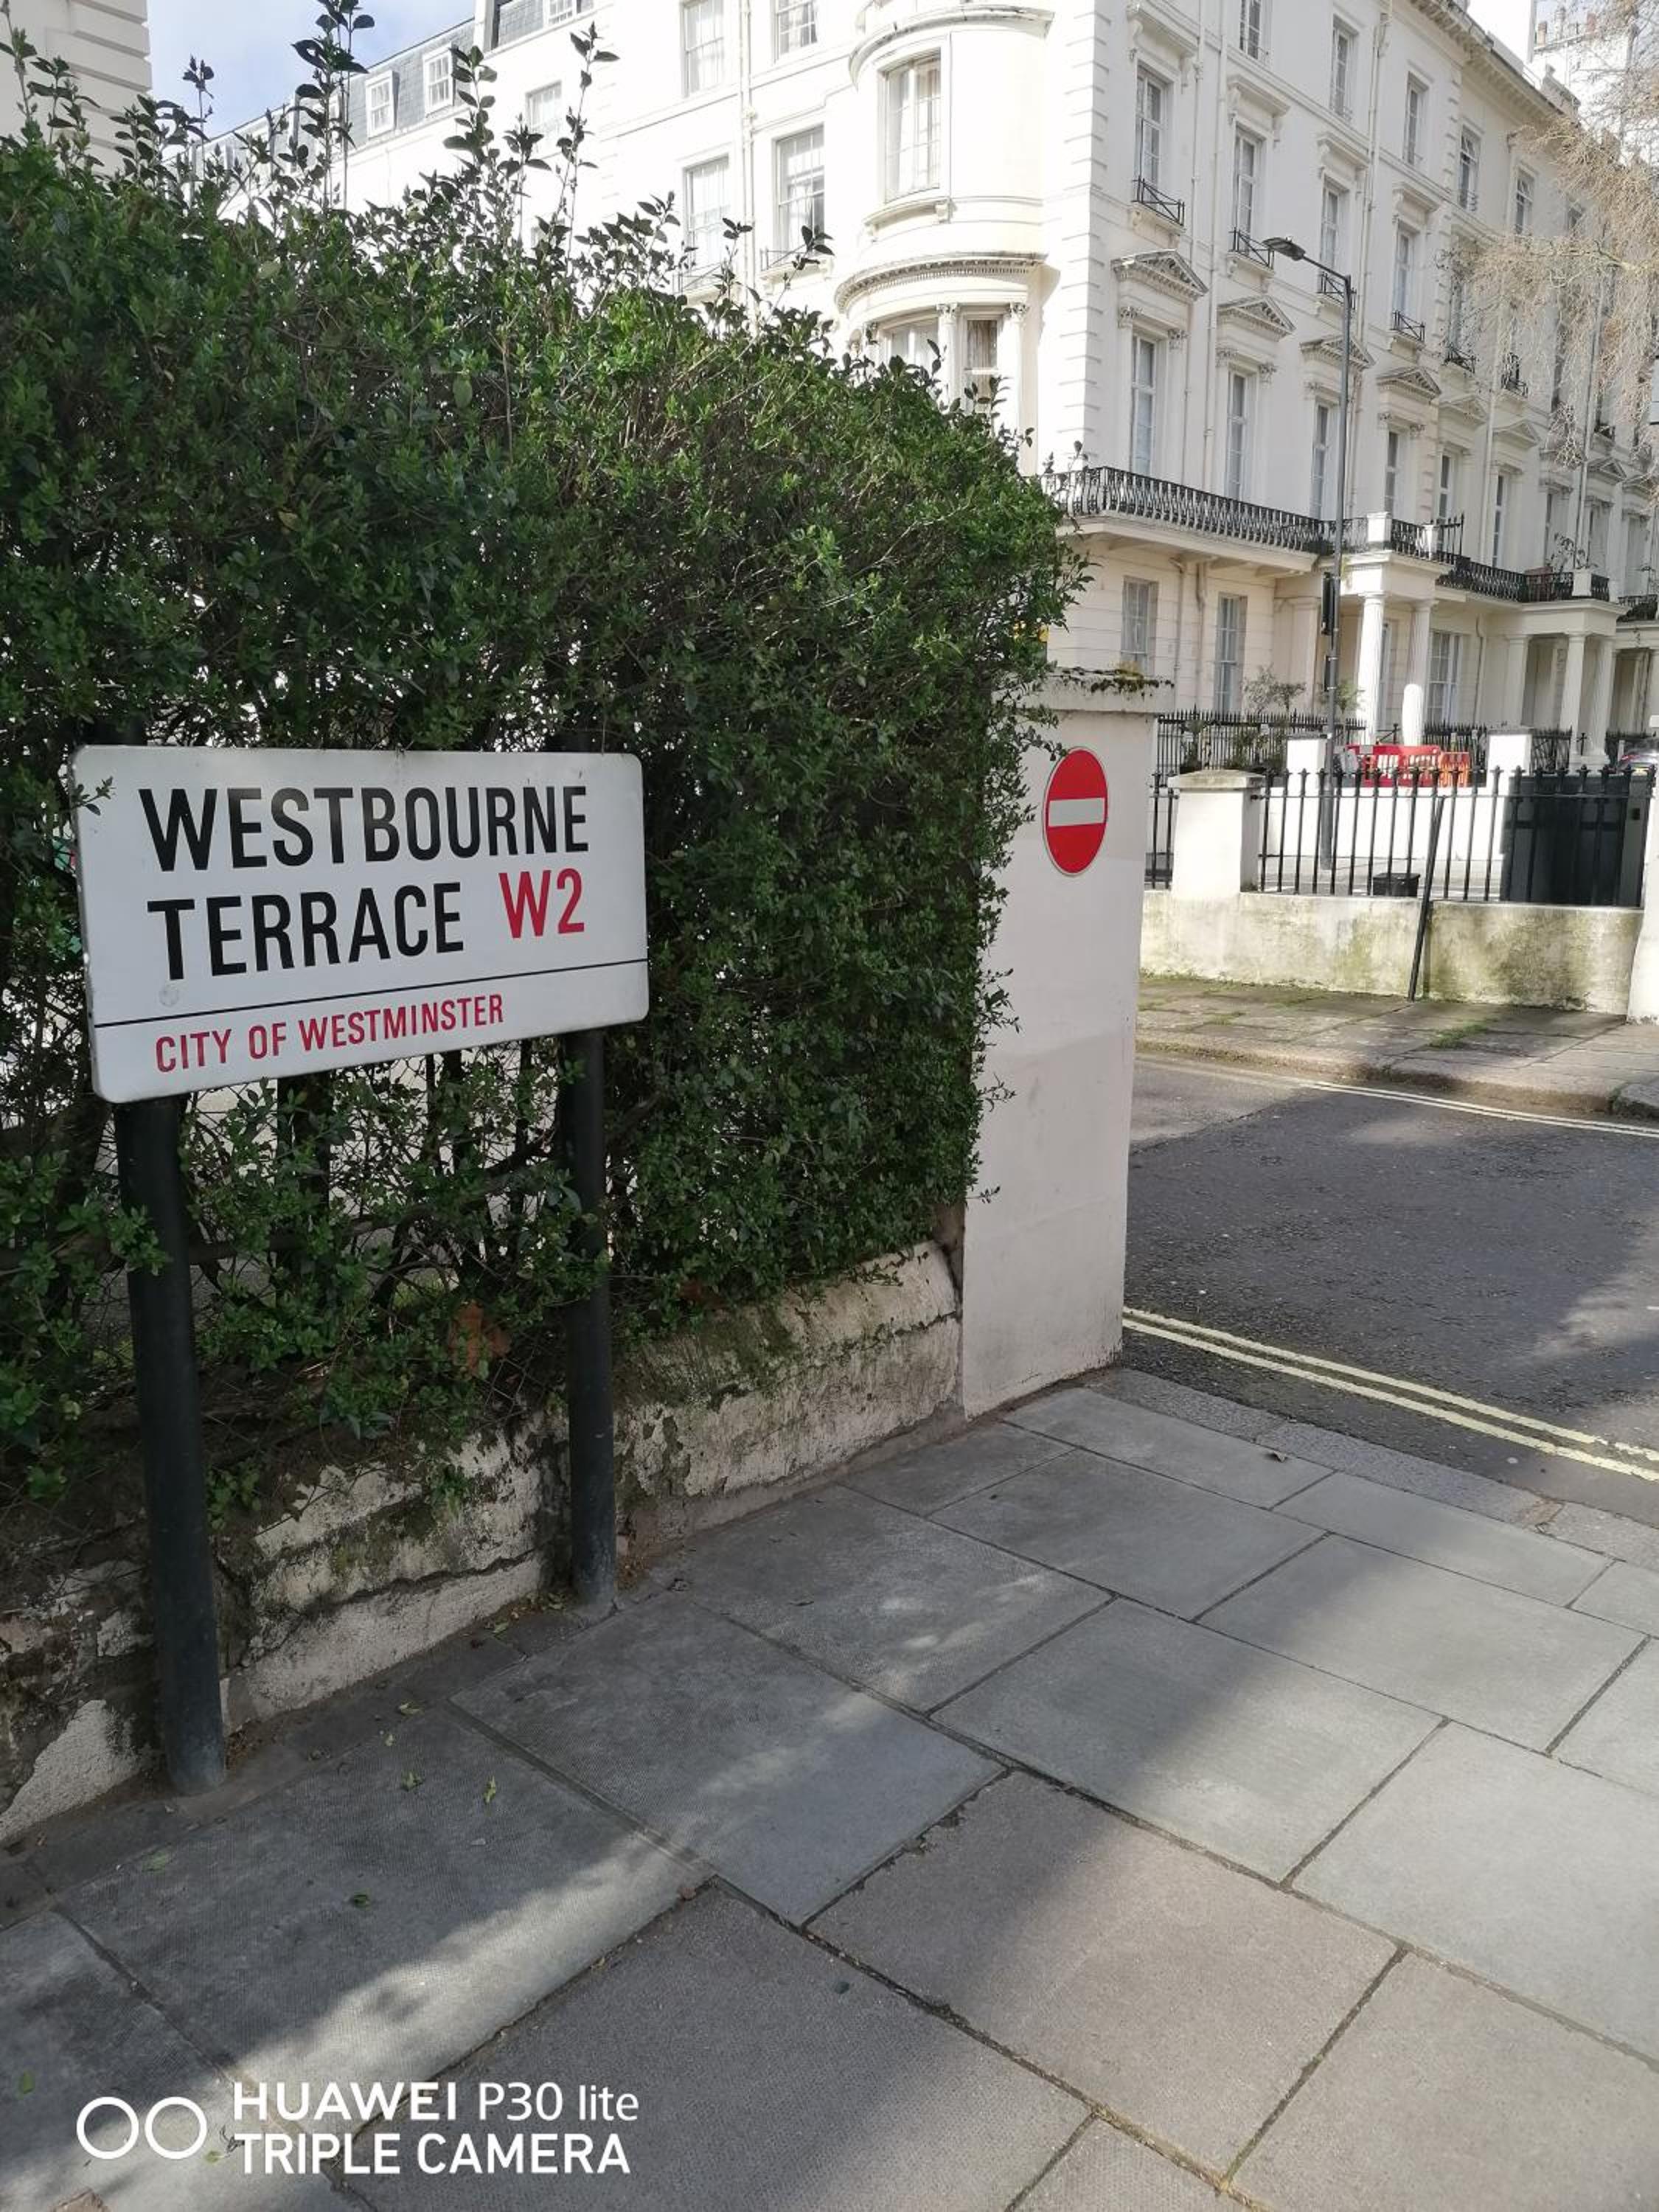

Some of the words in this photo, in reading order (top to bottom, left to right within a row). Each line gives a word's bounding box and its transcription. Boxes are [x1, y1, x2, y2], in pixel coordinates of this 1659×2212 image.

[139, 785, 589, 872] WESTBOURNE
[147, 882, 465, 981] TERRACE
[498, 868, 585, 939] W2
[156, 1029, 232, 1072] CITY
[248, 1023, 286, 1060] OF
[299, 994, 504, 1052] WESTMINSTER
